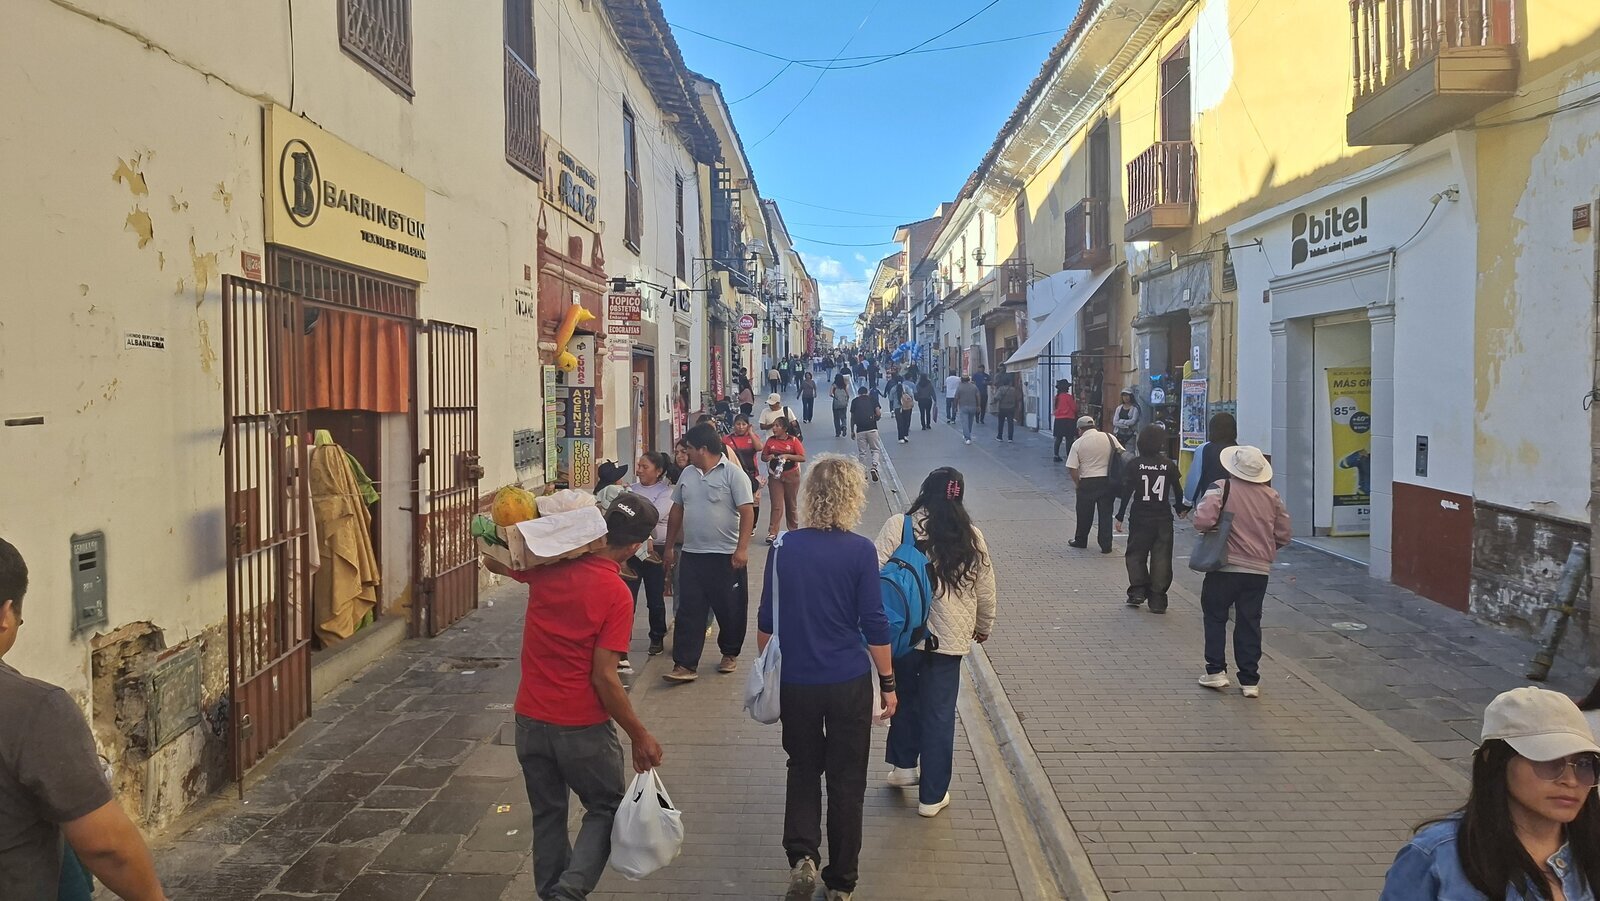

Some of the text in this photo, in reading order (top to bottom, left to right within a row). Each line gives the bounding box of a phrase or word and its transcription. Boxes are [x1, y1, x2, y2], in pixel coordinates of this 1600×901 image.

[323, 180, 425, 240] BARRINGTON
[1309, 196, 1368, 244] bitel
[609, 296, 640, 306] TOPICO
[609, 305, 640, 313] OBSTETRA
[577, 354, 585, 385] CUNAS
[1333, 377, 1356, 388] MÁS
[572, 389, 582, 436] AGENTE
[583, 389, 591, 436] MULTIBANCO
[573, 440, 581, 487] HELADOS
[582, 443, 590, 484] FRITOS
[1141, 474, 1166, 501] 14
[617, 503, 636, 517] adidas
